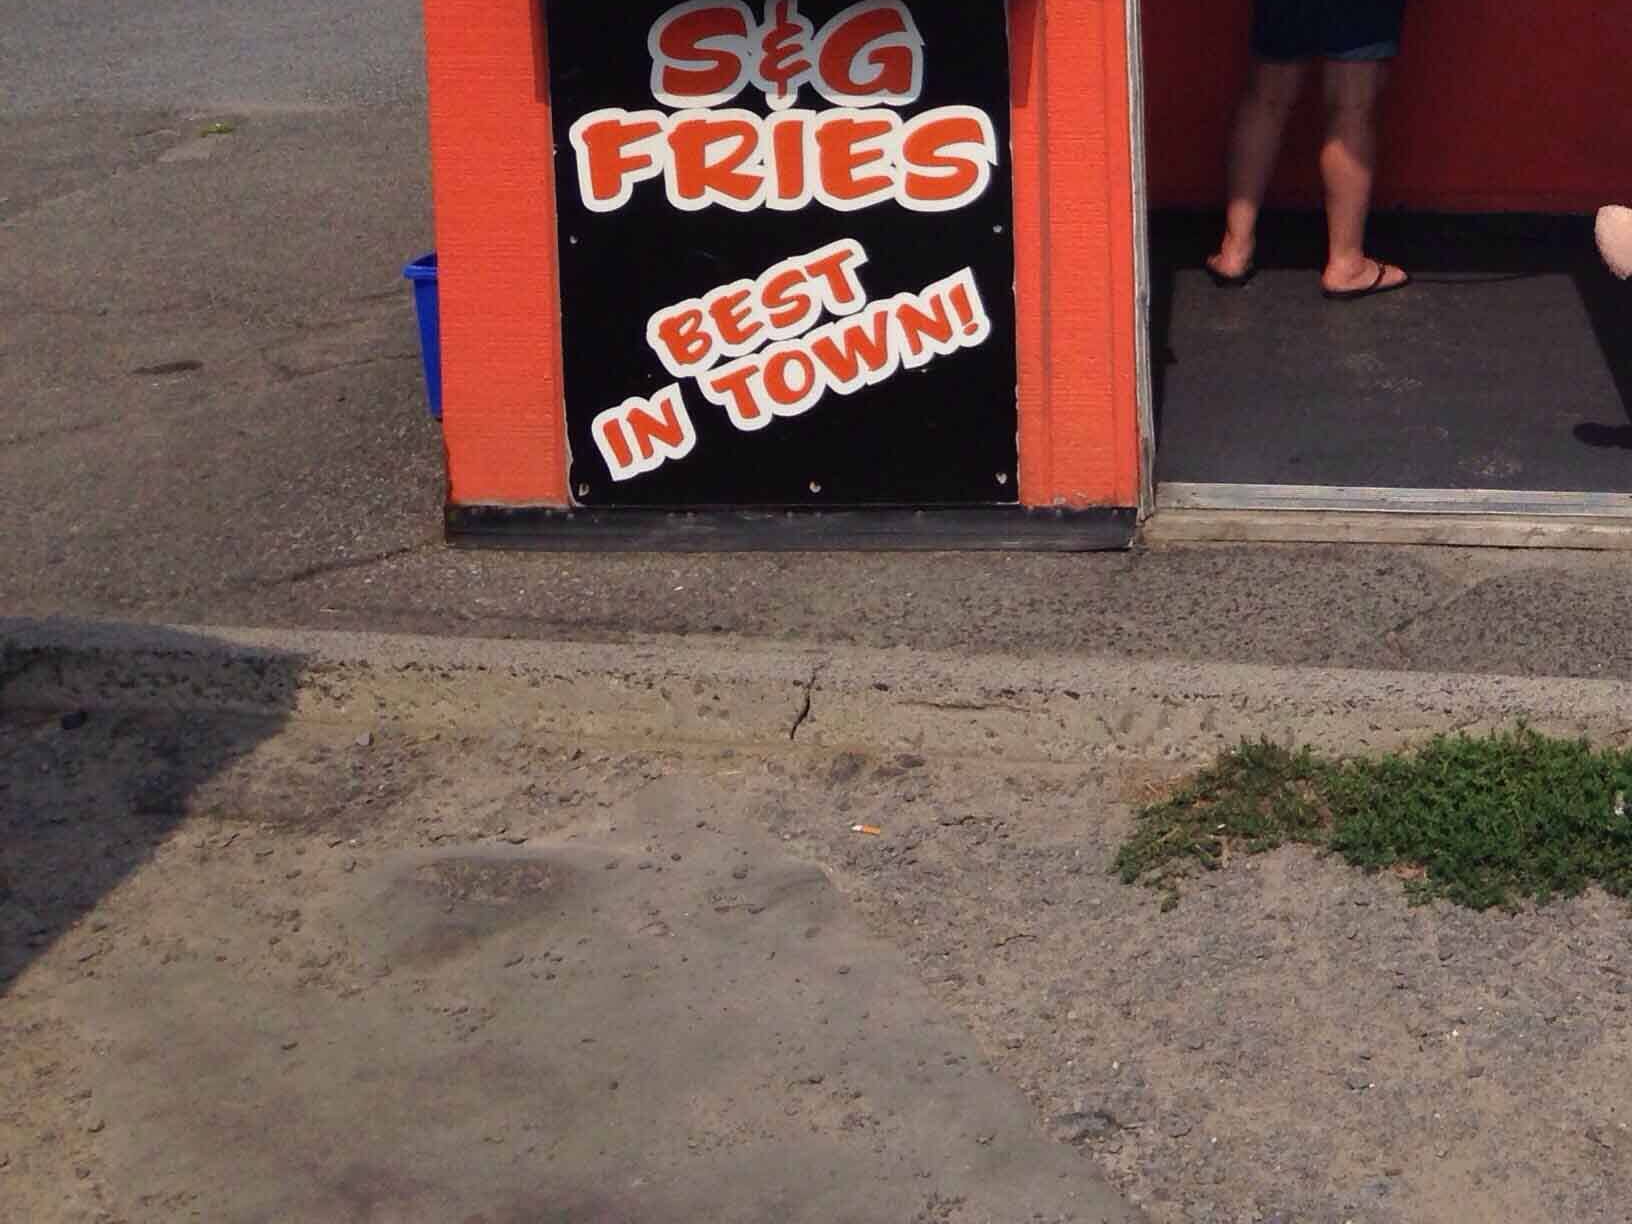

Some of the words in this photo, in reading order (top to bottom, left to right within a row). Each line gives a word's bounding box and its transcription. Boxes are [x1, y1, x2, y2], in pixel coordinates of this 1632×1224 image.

[569, 104, 998, 212] FRIES
[592, 382, 697, 481] IN
[697, 266, 991, 432] TOWN!
[646, 237, 869, 378] BEST
